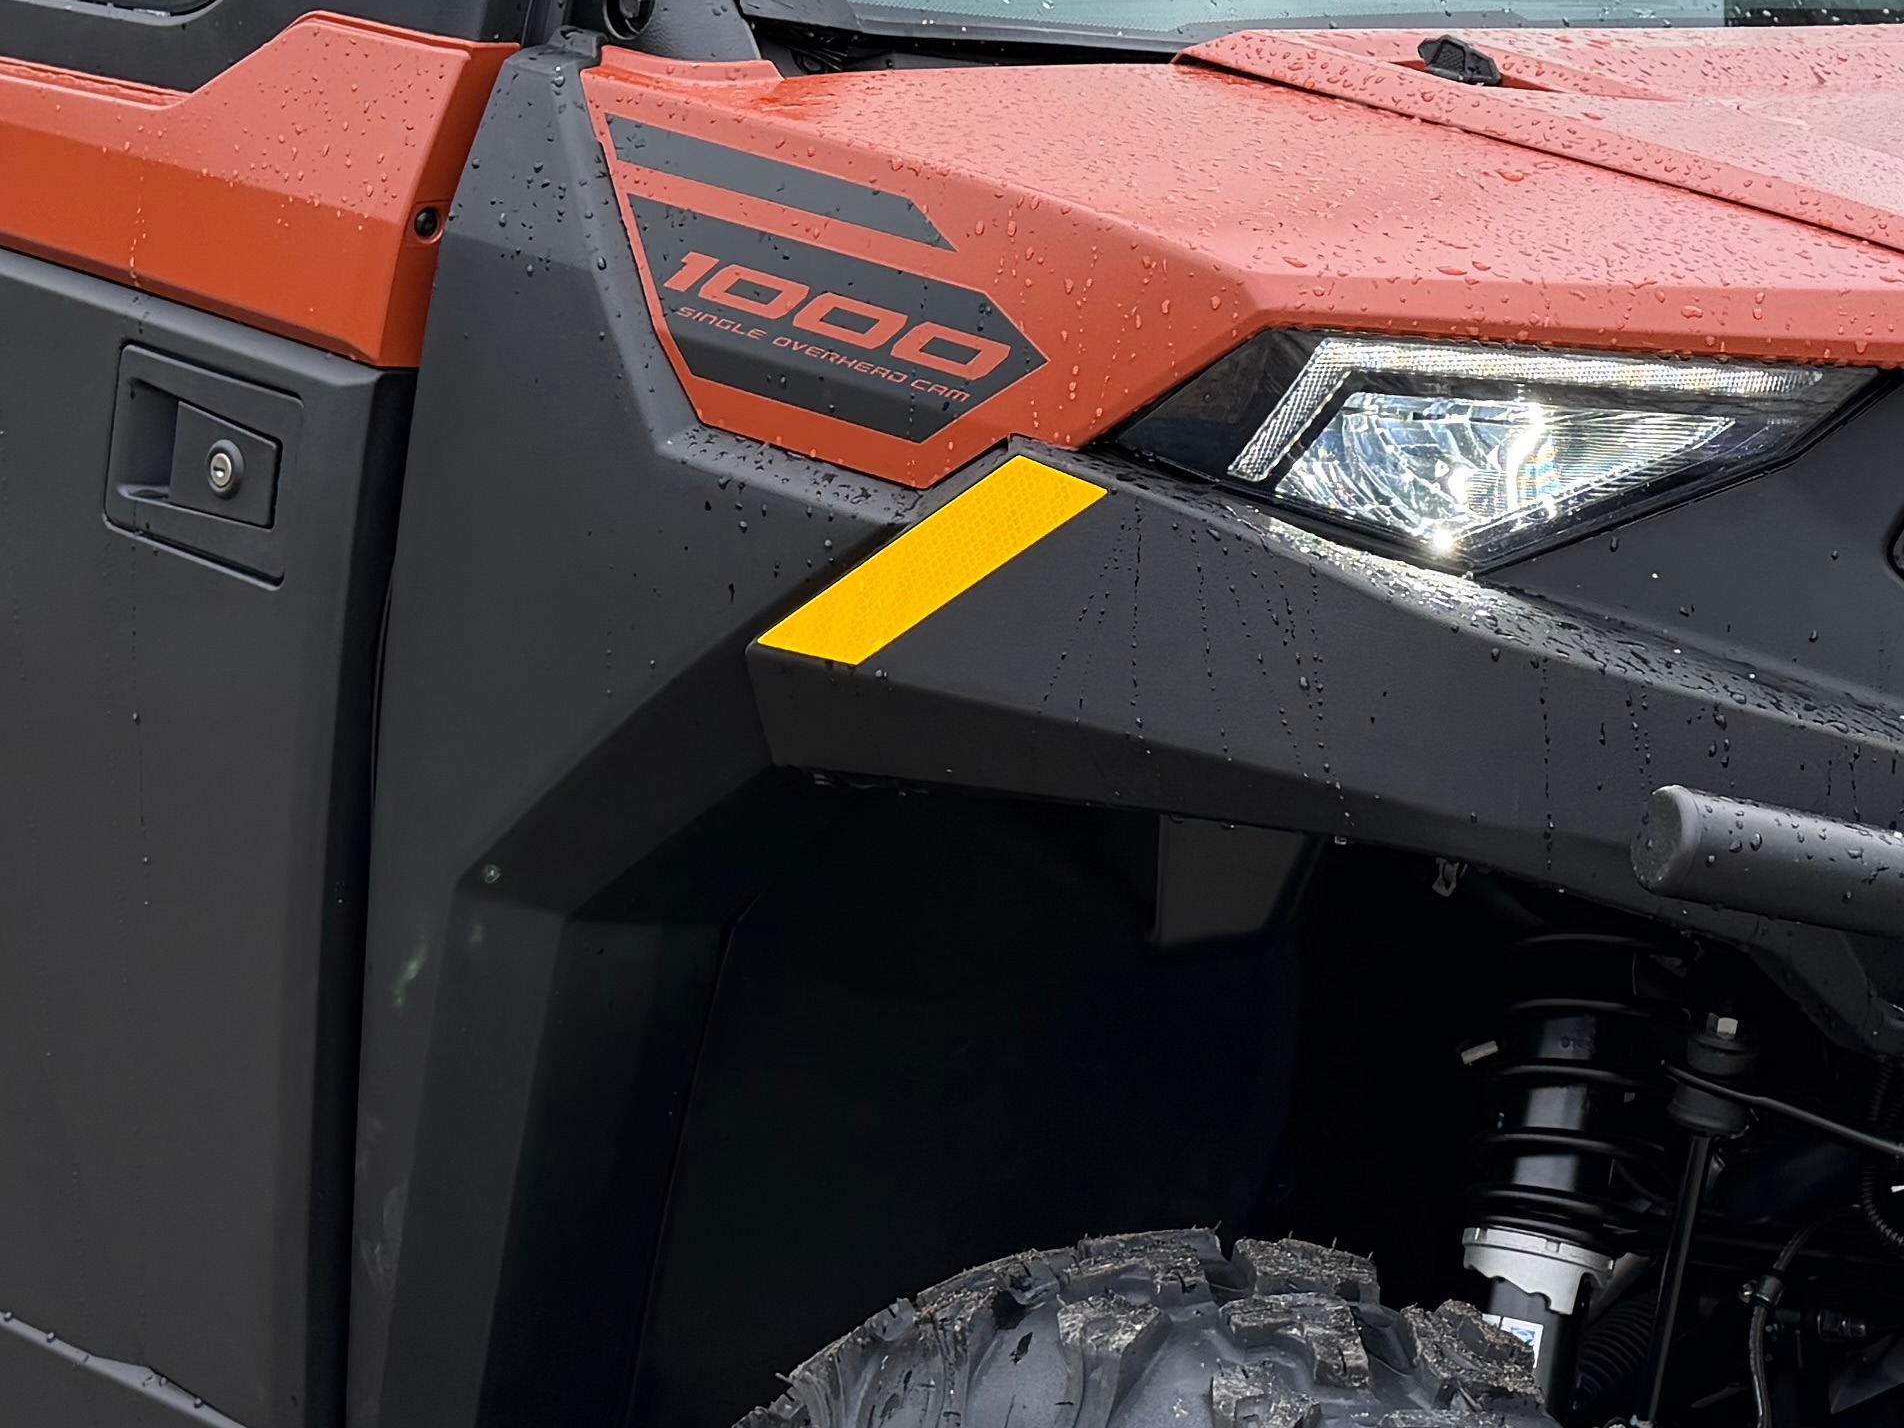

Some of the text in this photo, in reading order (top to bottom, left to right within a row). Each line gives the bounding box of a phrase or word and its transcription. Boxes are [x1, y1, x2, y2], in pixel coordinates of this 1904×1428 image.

[663, 251, 1011, 380] 1000
[676, 306, 971, 403] SINGLE OVERHEAD CAM
